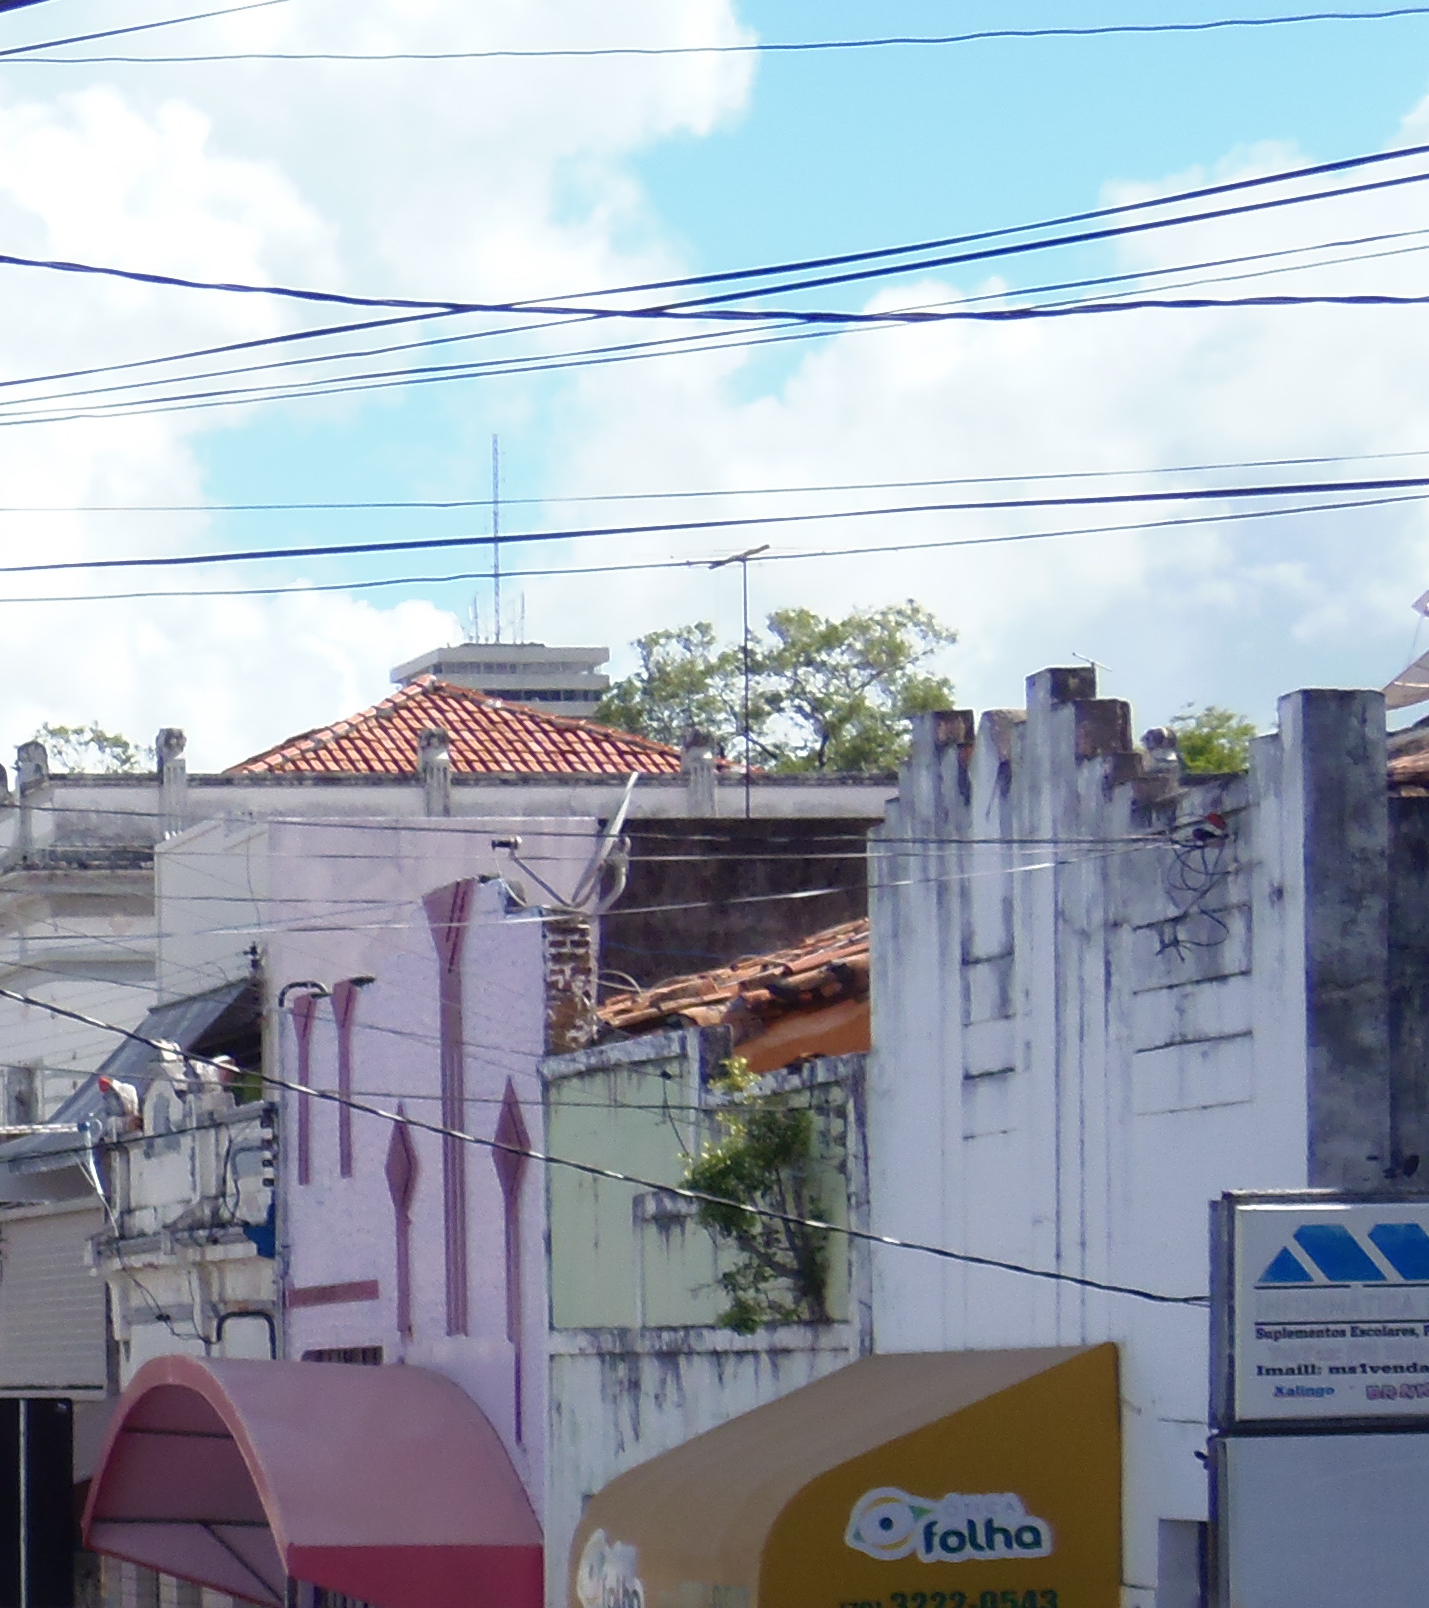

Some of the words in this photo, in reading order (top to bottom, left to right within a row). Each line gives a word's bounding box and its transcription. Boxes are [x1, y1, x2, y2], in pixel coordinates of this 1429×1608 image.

[1255, 1327, 1346, 1342] Suplementos
[1350, 1325, 1419, 1340] Escolares,
[923, 1517, 1043, 1555] folha
